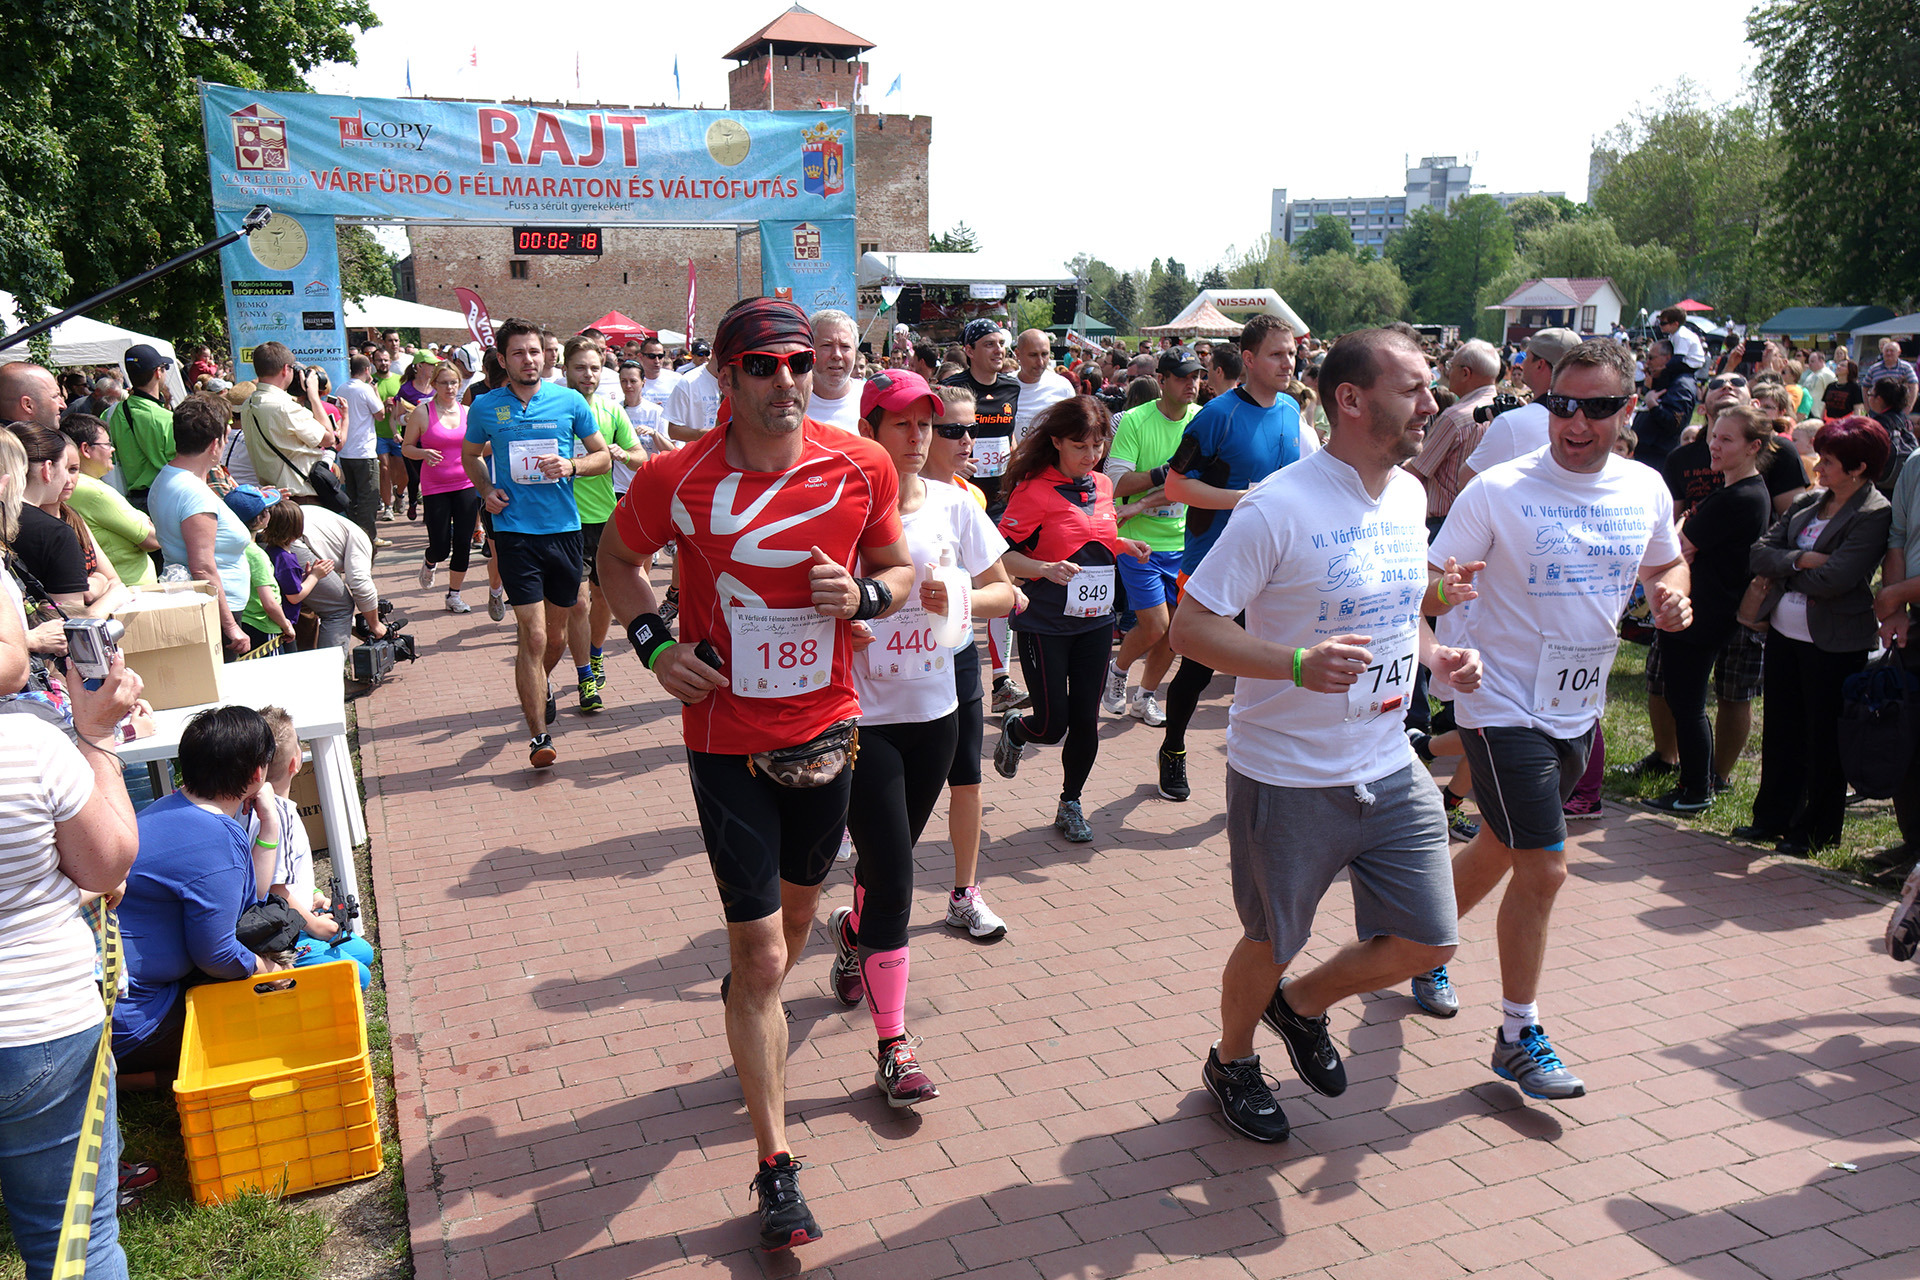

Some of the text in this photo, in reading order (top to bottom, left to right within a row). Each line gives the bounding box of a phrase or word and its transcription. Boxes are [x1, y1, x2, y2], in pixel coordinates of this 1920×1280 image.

[345, 121, 358, 136] ART
[344, 140, 416, 149] STUDIO
[477, 107, 648, 168] RAJT
[240, 186, 293, 196] GYULA
[310, 167, 798, 200] VÁRFÜRDŐ FÉLMARATON ÉS VÁLTÓFUTÁS
[541, 202, 568, 211] sérült
[814, 289, 848, 310] Gyula
[1217, 298, 1266, 306] NISSAN
[974, 413, 1014, 424] Finisher
[982, 451, 1007, 465] 336
[1521, 505, 1645, 518] VI. Várfürdő félmaraton
[1581, 519, 1647, 533] és váltófutás
[1311, 533, 1328, 549] VI.
[1331, 523, 1378, 545] Várfürdő
[1374, 541, 1384, 555] és
[1587, 545, 1617, 556] 2014.
[1619, 544, 1634, 556] 05.
[1381, 568, 1421, 583] 2014. 05.
[1078, 584, 1108, 601] 849
[961, 586, 969, 620] karrimor
[886, 627, 937, 655] 440
[757, 639, 818, 669] 188
[1367, 653, 1414, 693] 747
[1557, 666, 1600, 691] 10A
